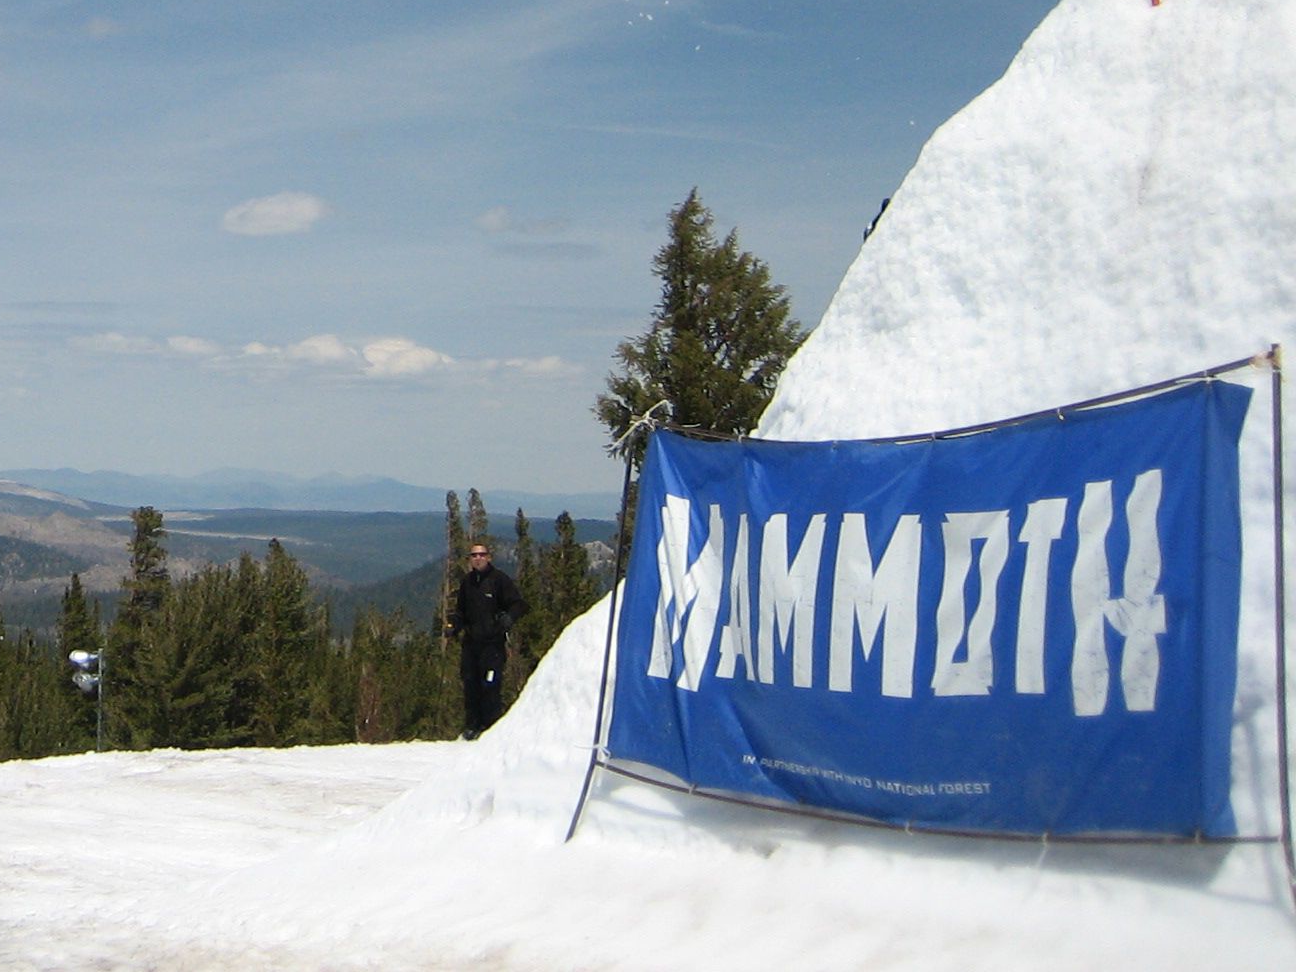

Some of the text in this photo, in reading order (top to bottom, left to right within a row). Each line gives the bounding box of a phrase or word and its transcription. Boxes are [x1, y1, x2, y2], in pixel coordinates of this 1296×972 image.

[647, 468, 1168, 717] MAMMOTH
[875, 780, 935, 796] NATIONAL
[938, 782, 992, 795] FOREST
